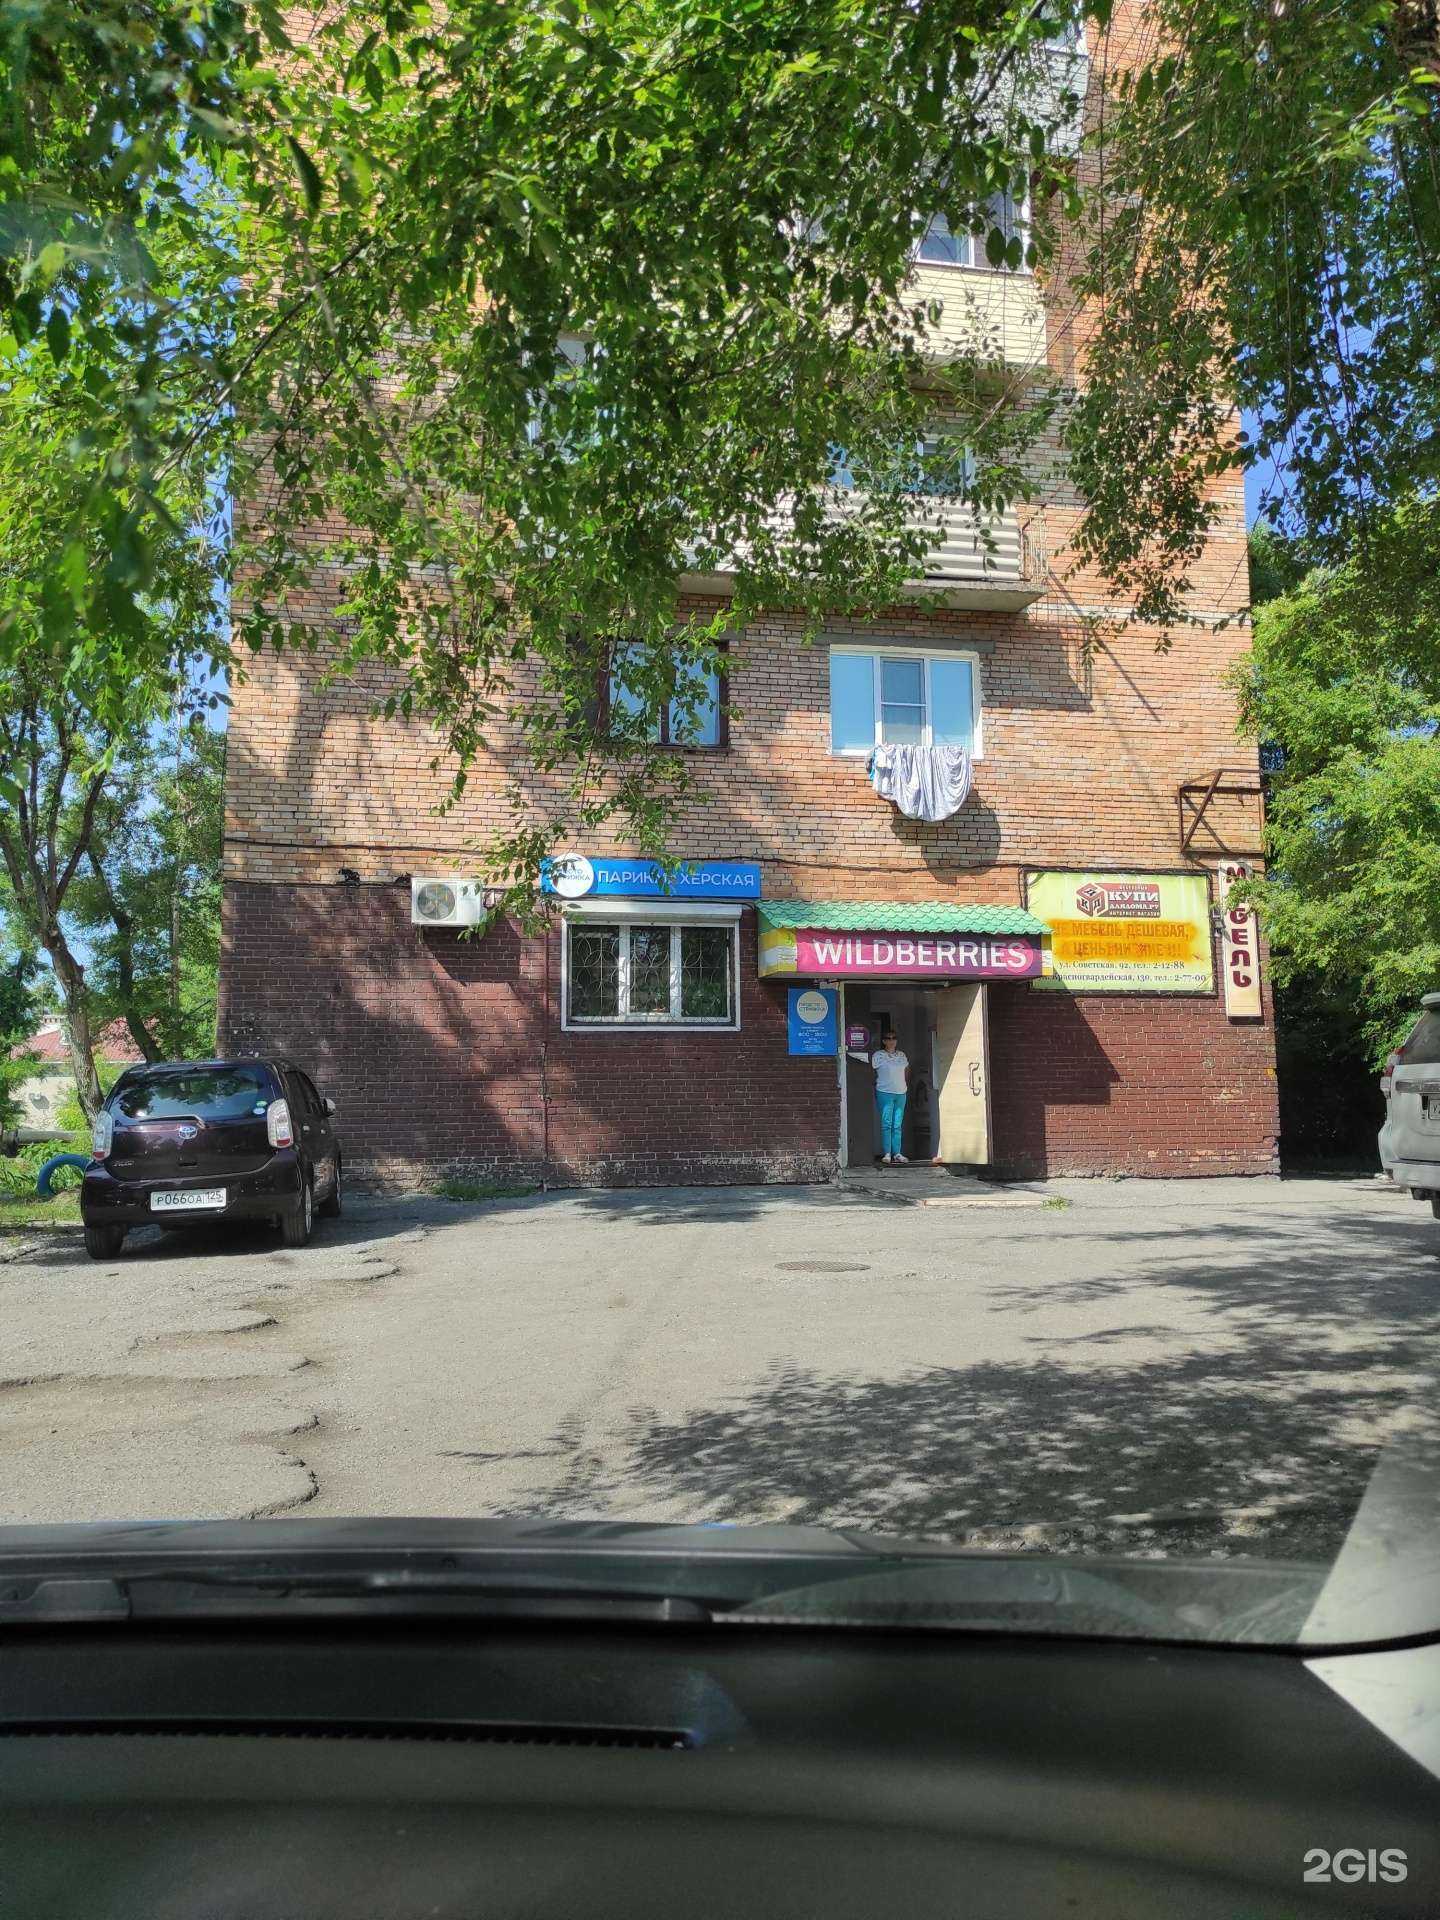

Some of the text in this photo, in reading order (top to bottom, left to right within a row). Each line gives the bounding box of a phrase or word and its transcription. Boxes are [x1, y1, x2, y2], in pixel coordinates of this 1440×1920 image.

[597, 870, 755, 887] ПАРИКМХЕРСКАЯ
[1109, 890, 1160, 902] КУПИ
[1072, 924, 1122, 937] МЕБЕЛЬ
[1127, 924, 1190, 942] ДЕШЕВАЯ,
[1226, 866, 1252, 988] МБЕЛЬ
[813, 938, 1027, 968] WILDBERRIES
[1072, 960, 1117, 970] Советская,
[1153, 960, 1185, 969] 2-12-88
[207, 1191, 222, 1200] 125
